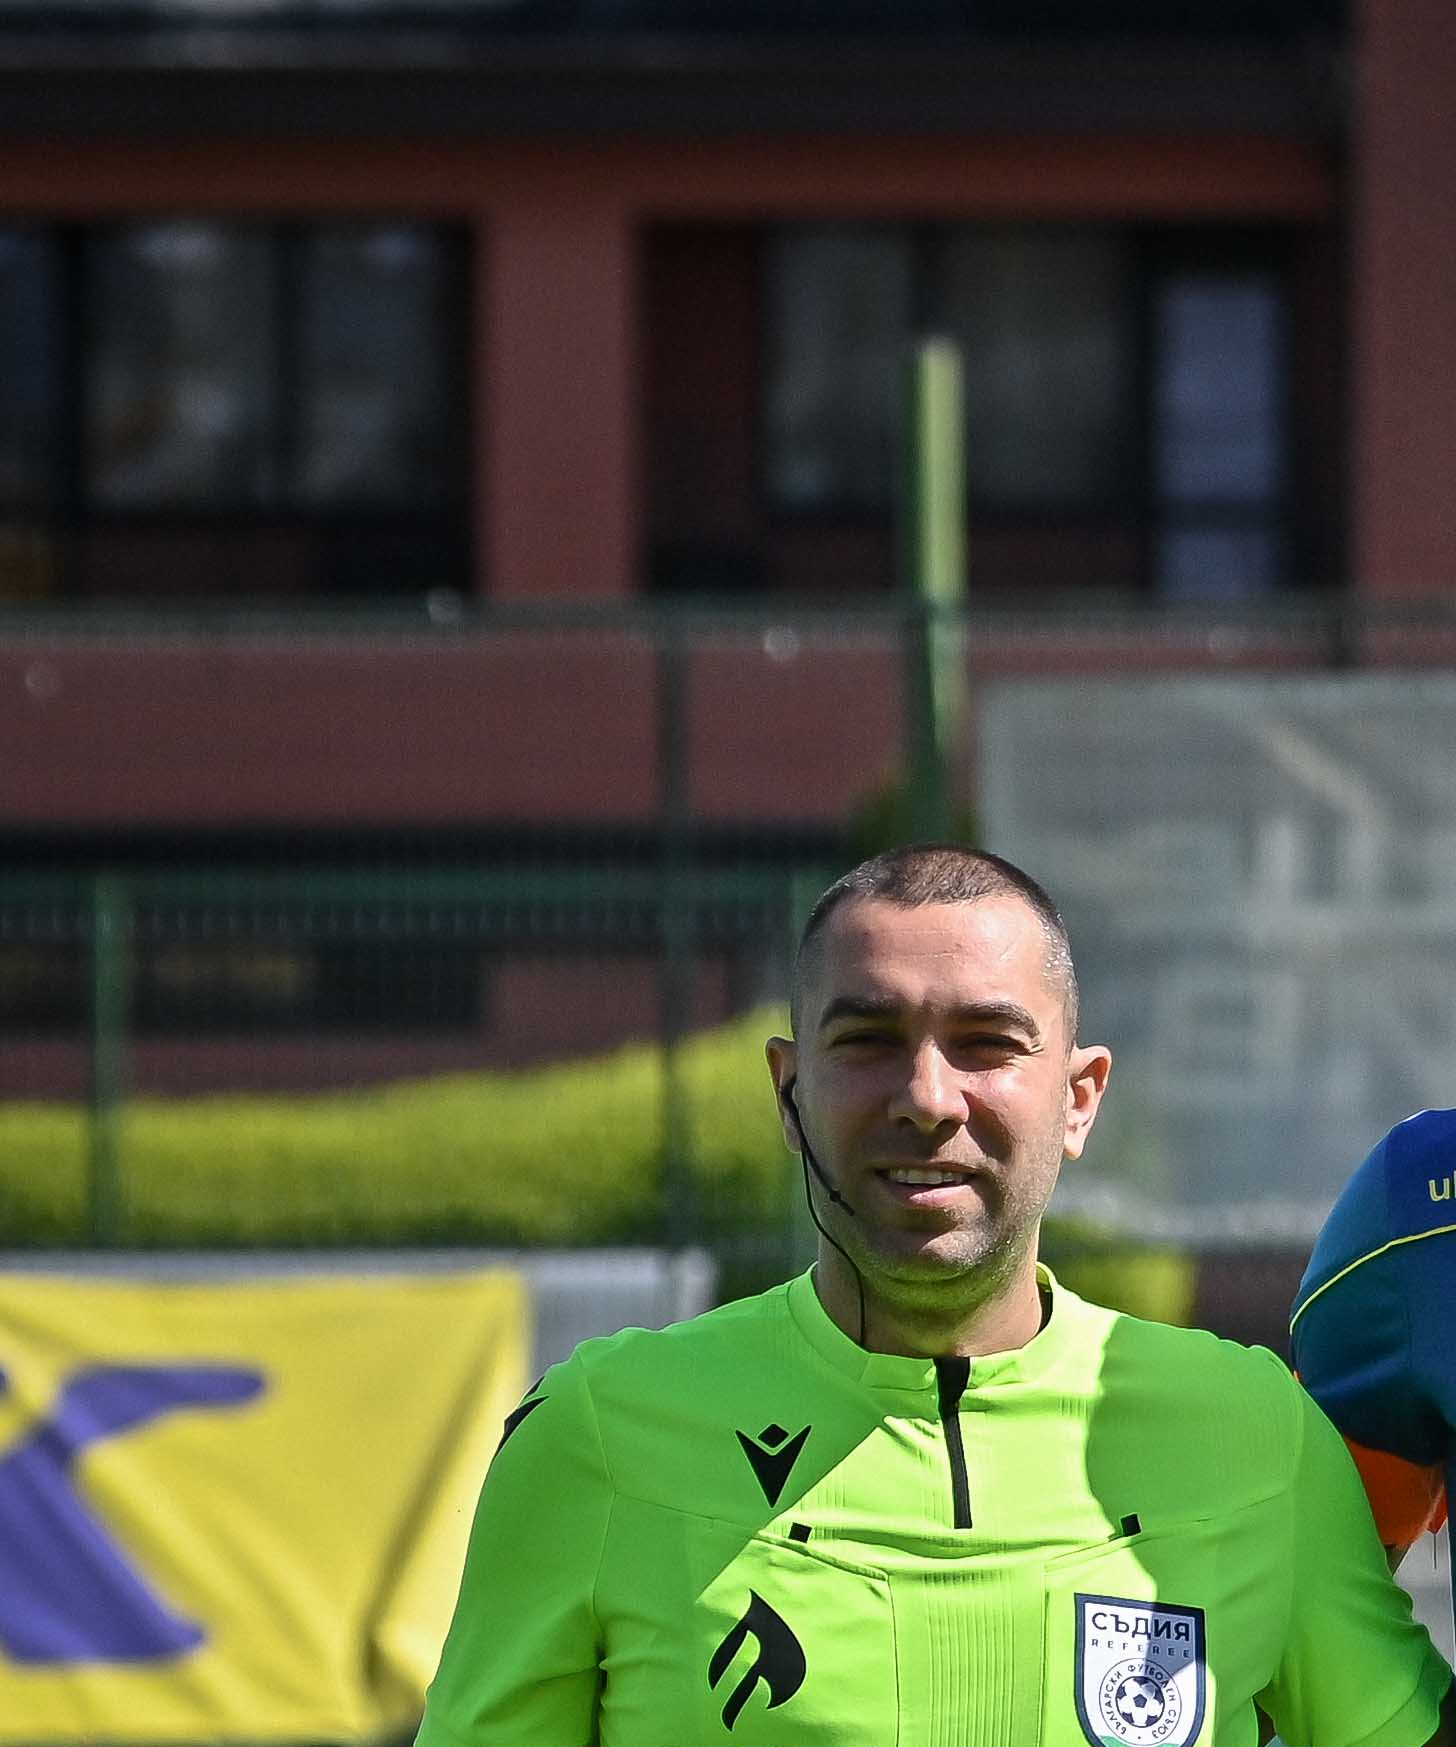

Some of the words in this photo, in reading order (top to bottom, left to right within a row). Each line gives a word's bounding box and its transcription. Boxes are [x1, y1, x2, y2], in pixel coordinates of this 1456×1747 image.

[1091, 1612, 1190, 1642] СЪДИЯ
[1091, 1638, 1191, 1659] REFEREE
[1104, 1670, 1127, 1736] БЪЛГАРСКИ
[1127, 1663, 1177, 1702] ФУТБОЛЕН
